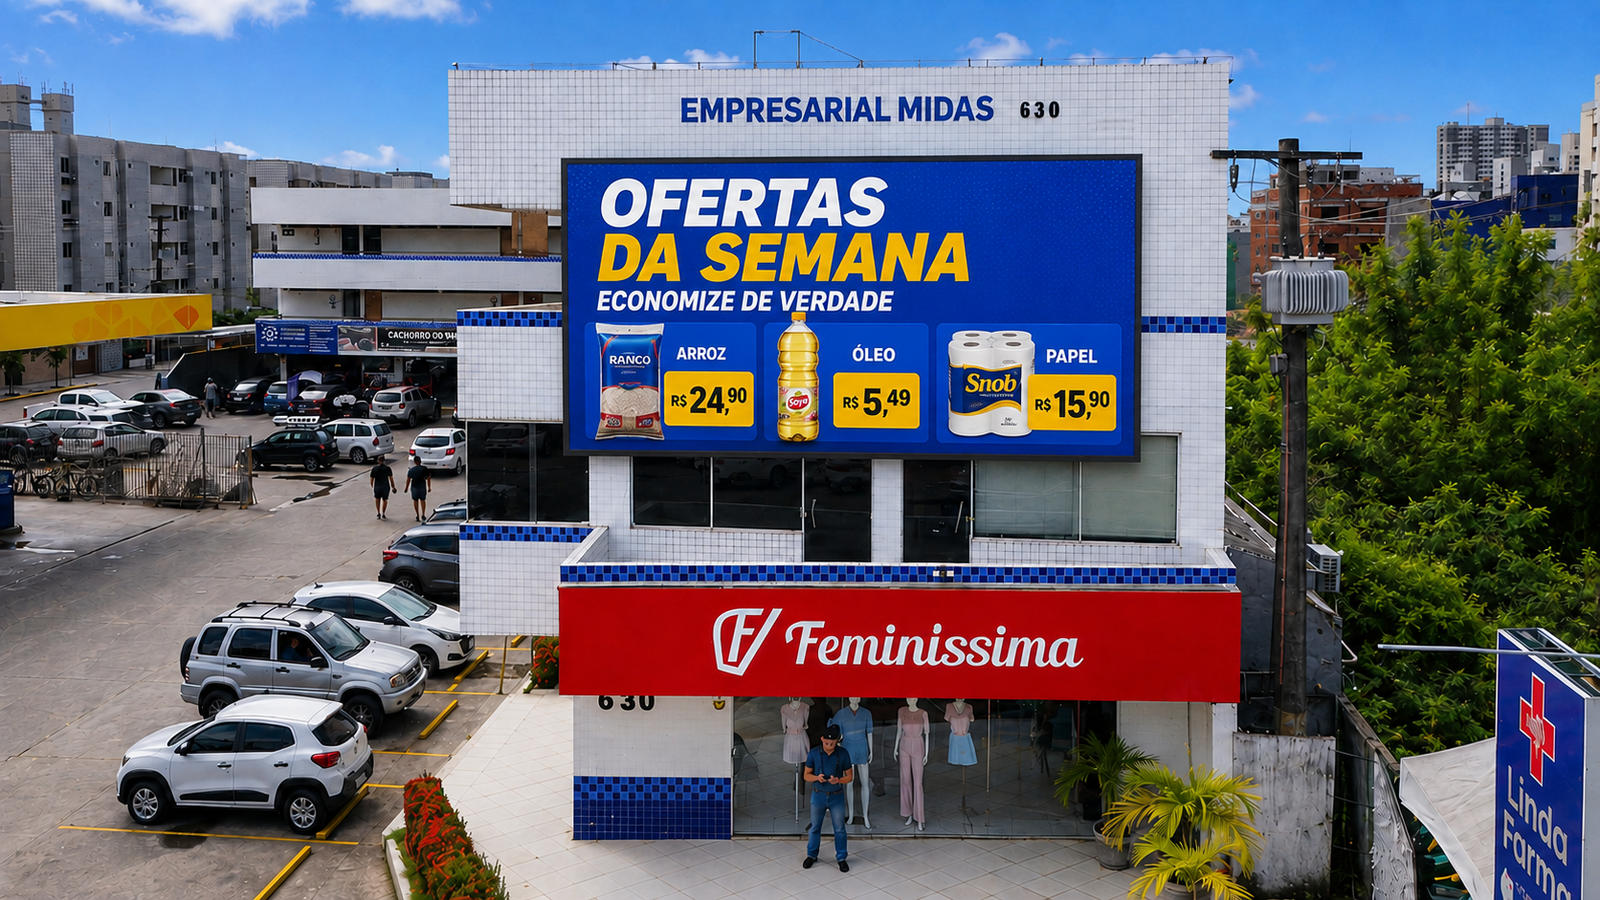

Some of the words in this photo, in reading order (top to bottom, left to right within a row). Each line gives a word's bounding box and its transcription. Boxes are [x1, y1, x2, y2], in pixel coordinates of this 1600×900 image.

[680, 96, 891, 124] EMPRESARIAL
[898, 95, 995, 122] MIDAS
[1020, 101, 1061, 119] 630
[600, 176, 889, 228] OFERTAS
[597, 233, 680, 282] DA
[699, 232, 970, 283] SEMANA
[596, 290, 735, 312] ECONOMIZE
[741, 290, 773, 312] DE
[780, 290, 895, 312] VERDADE
[609, 355, 651, 365] RANCO
[676, 347, 727, 361] ARROZ
[852, 344, 896, 362] ÓLEO
[1046, 349, 1098, 364] PAPEL
[964, 373, 1017, 393] Snob
[671, 394, 688, 408] R$
[843, 396, 859, 410] R$
[1035, 398, 1051, 412] R$
[785, 620, 1084, 668] Feminissima
[598, 695, 655, 711] 630
[1507, 765, 1568, 867] Linda
